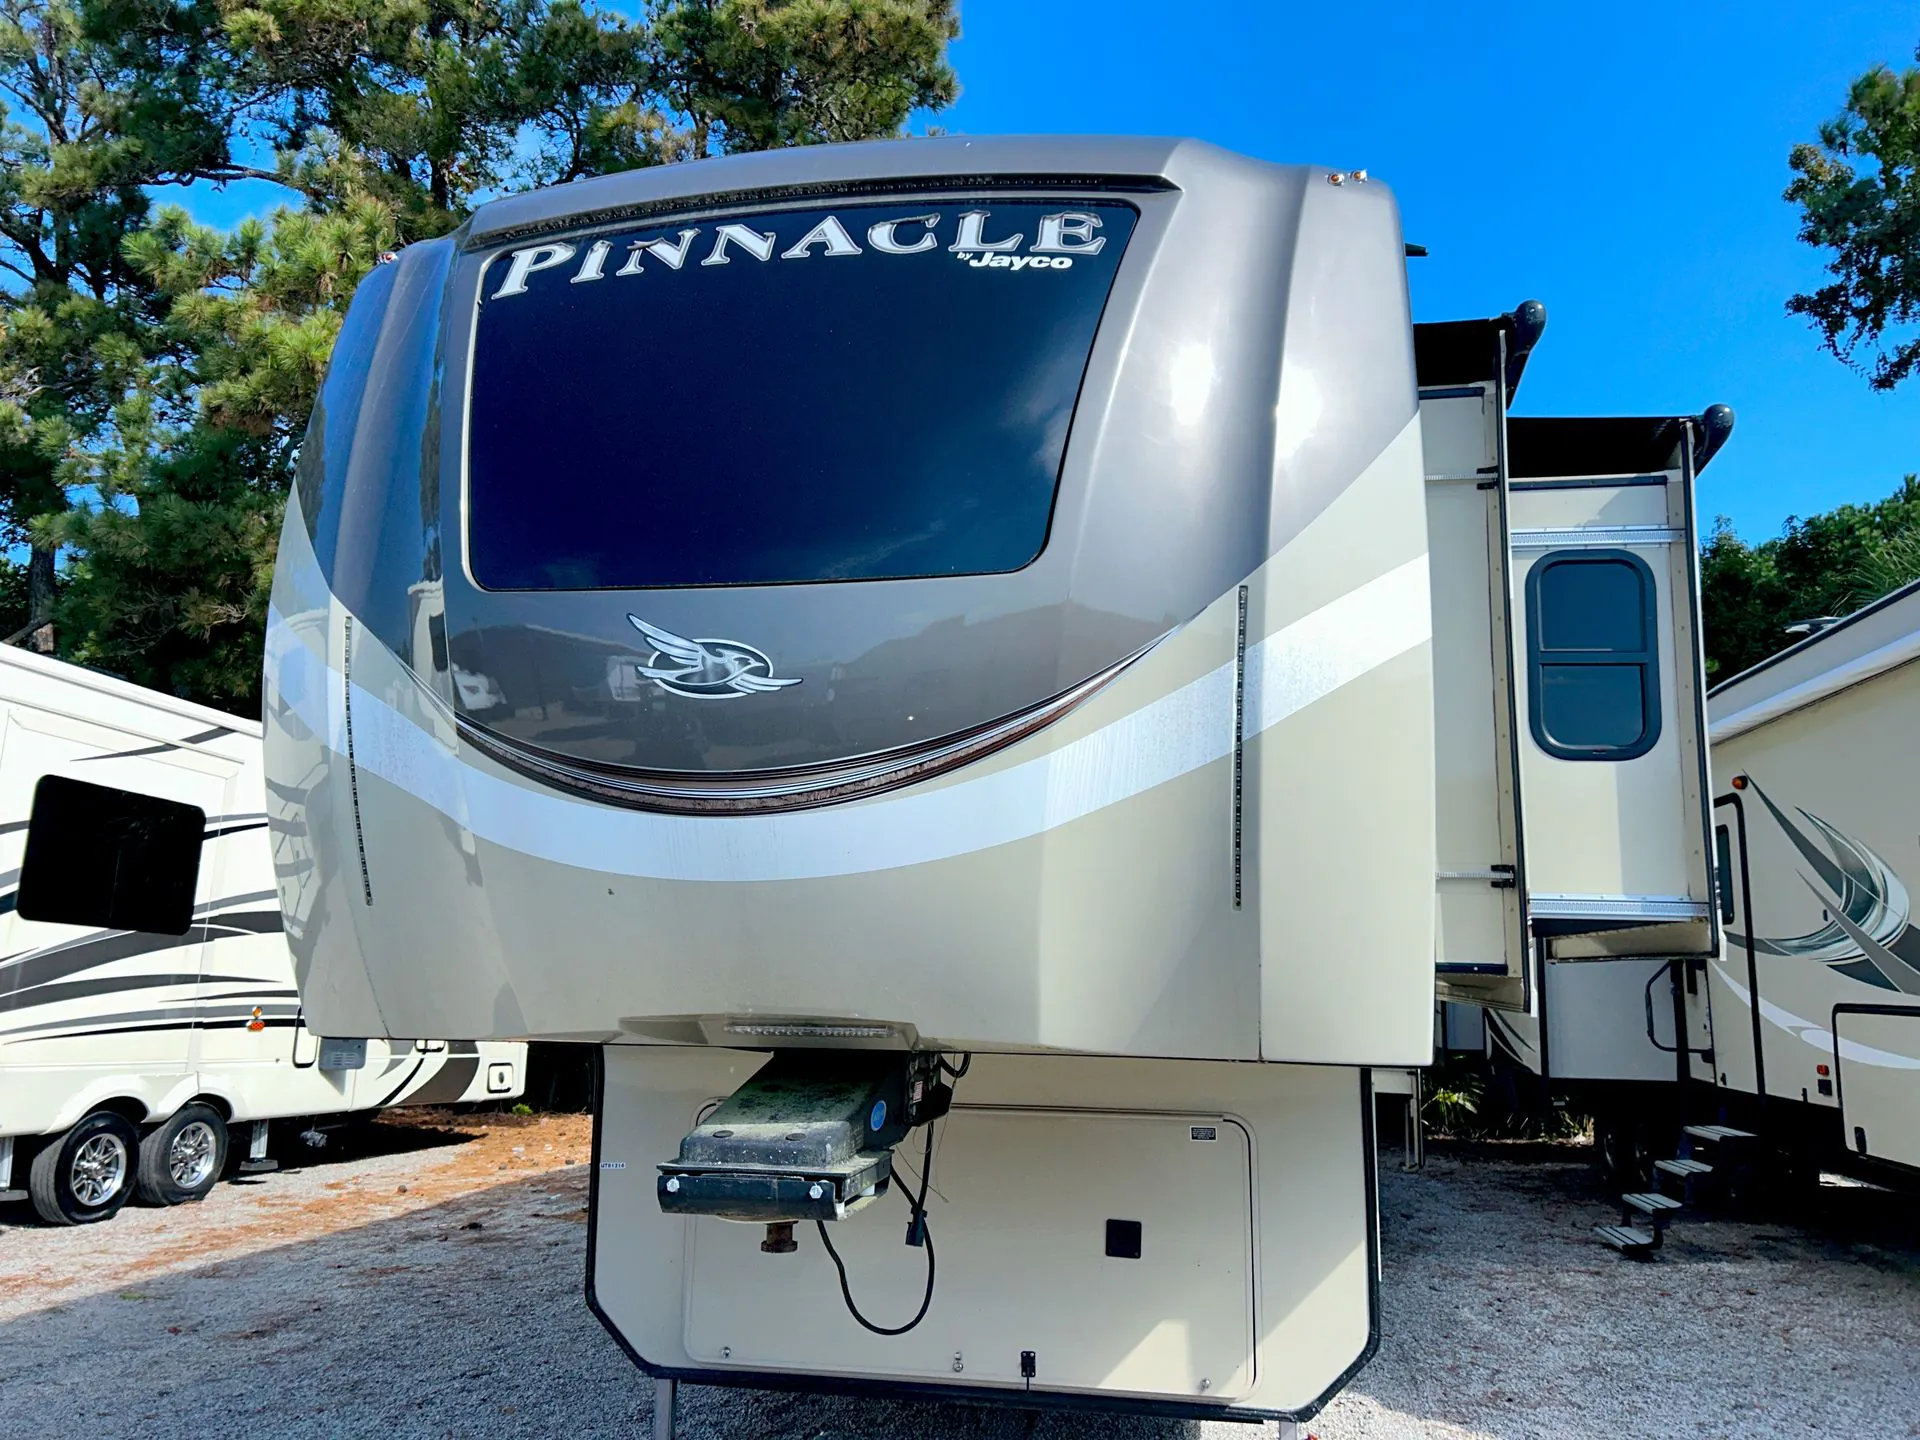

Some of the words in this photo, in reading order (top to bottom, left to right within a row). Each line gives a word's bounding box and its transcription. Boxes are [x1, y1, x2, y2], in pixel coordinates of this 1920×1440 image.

[491, 209, 1107, 300] PINNACLE
[956, 251, 974, 261] by
[969, 252, 1073, 271] Jayco
